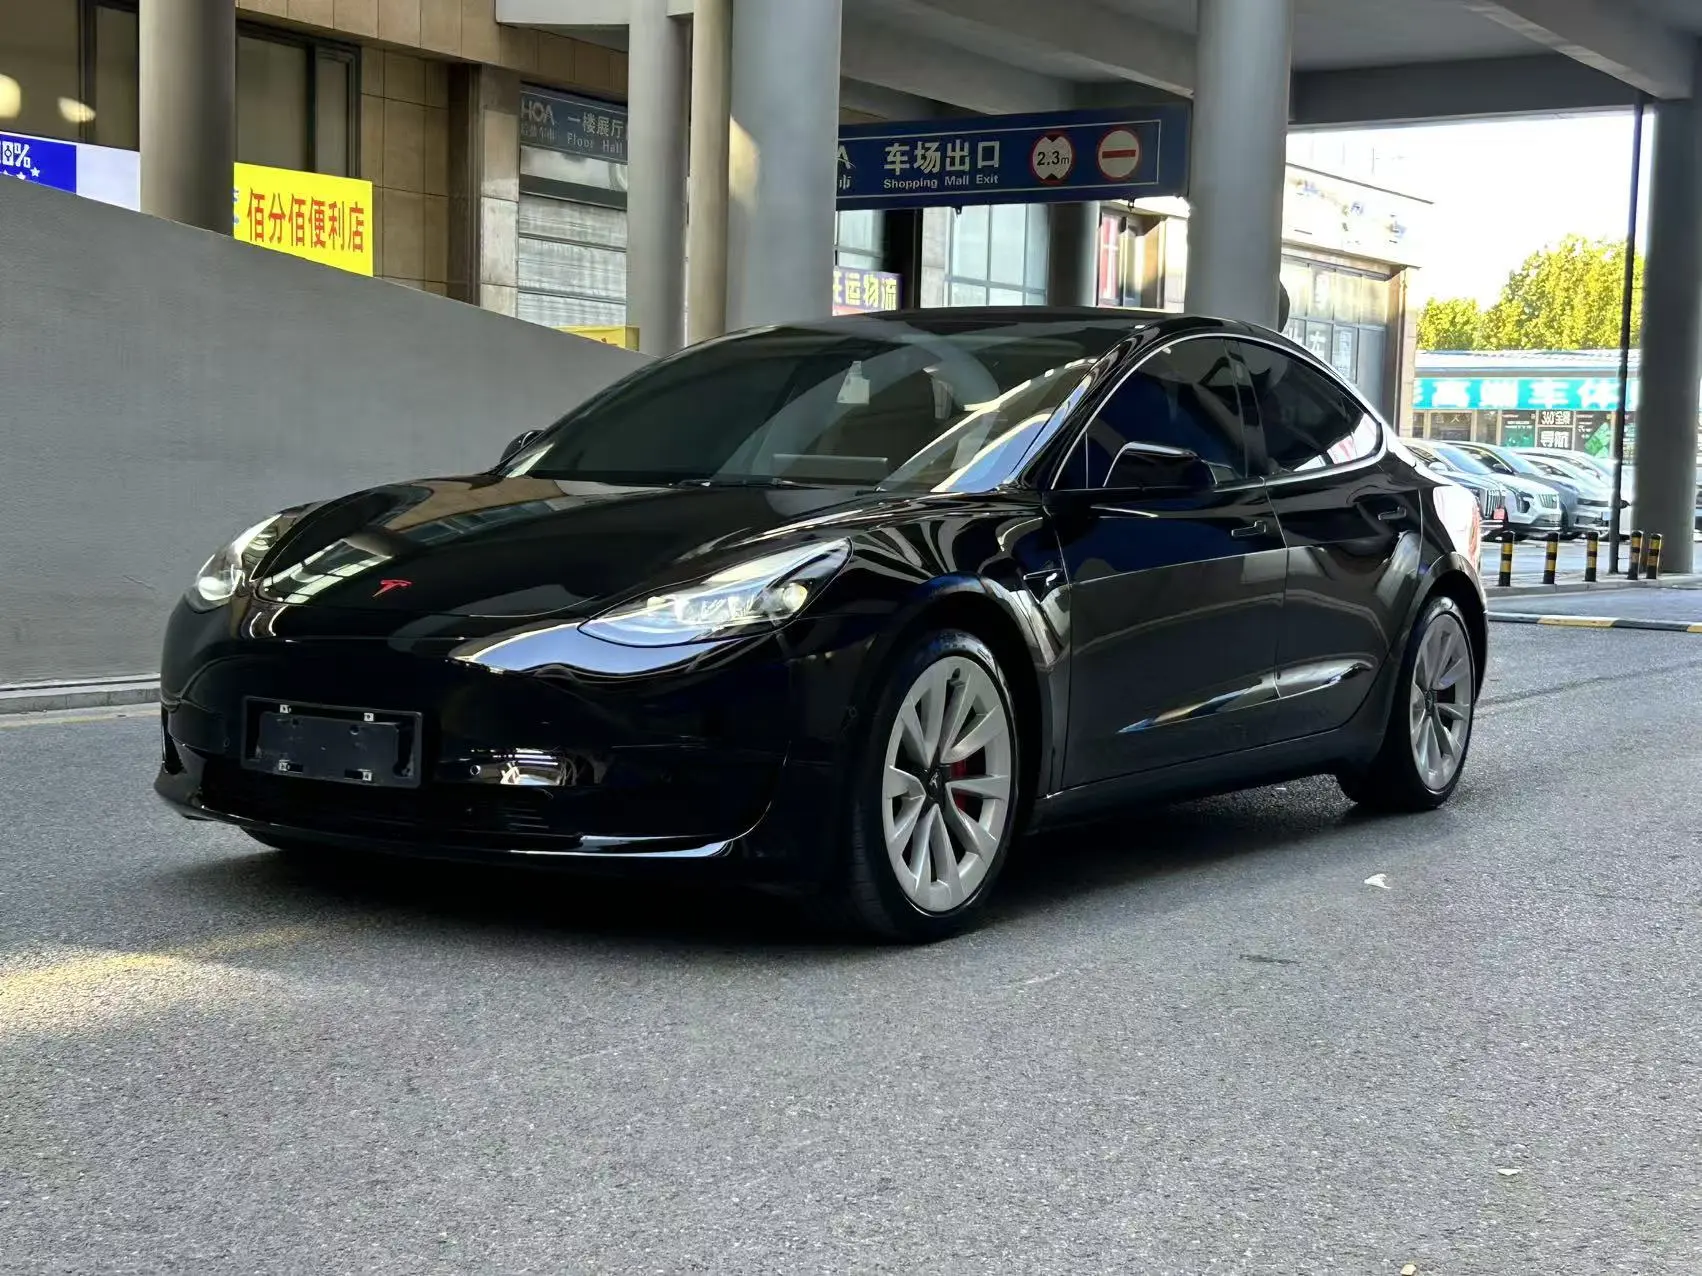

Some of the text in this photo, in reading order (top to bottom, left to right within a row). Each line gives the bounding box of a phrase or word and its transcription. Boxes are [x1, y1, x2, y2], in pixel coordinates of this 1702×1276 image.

[521, 99, 554, 125] HOA
[567, 112, 624, 139] 一楼展厅
[602, 139, 623, 153] Hall
[884, 139, 1000, 175] 车场出口
[1036, 151, 1070, 166] 2.3m
[883, 174, 999, 190] Shopping Mall Exit
[247, 187, 365, 253] 佰分佰便利店
